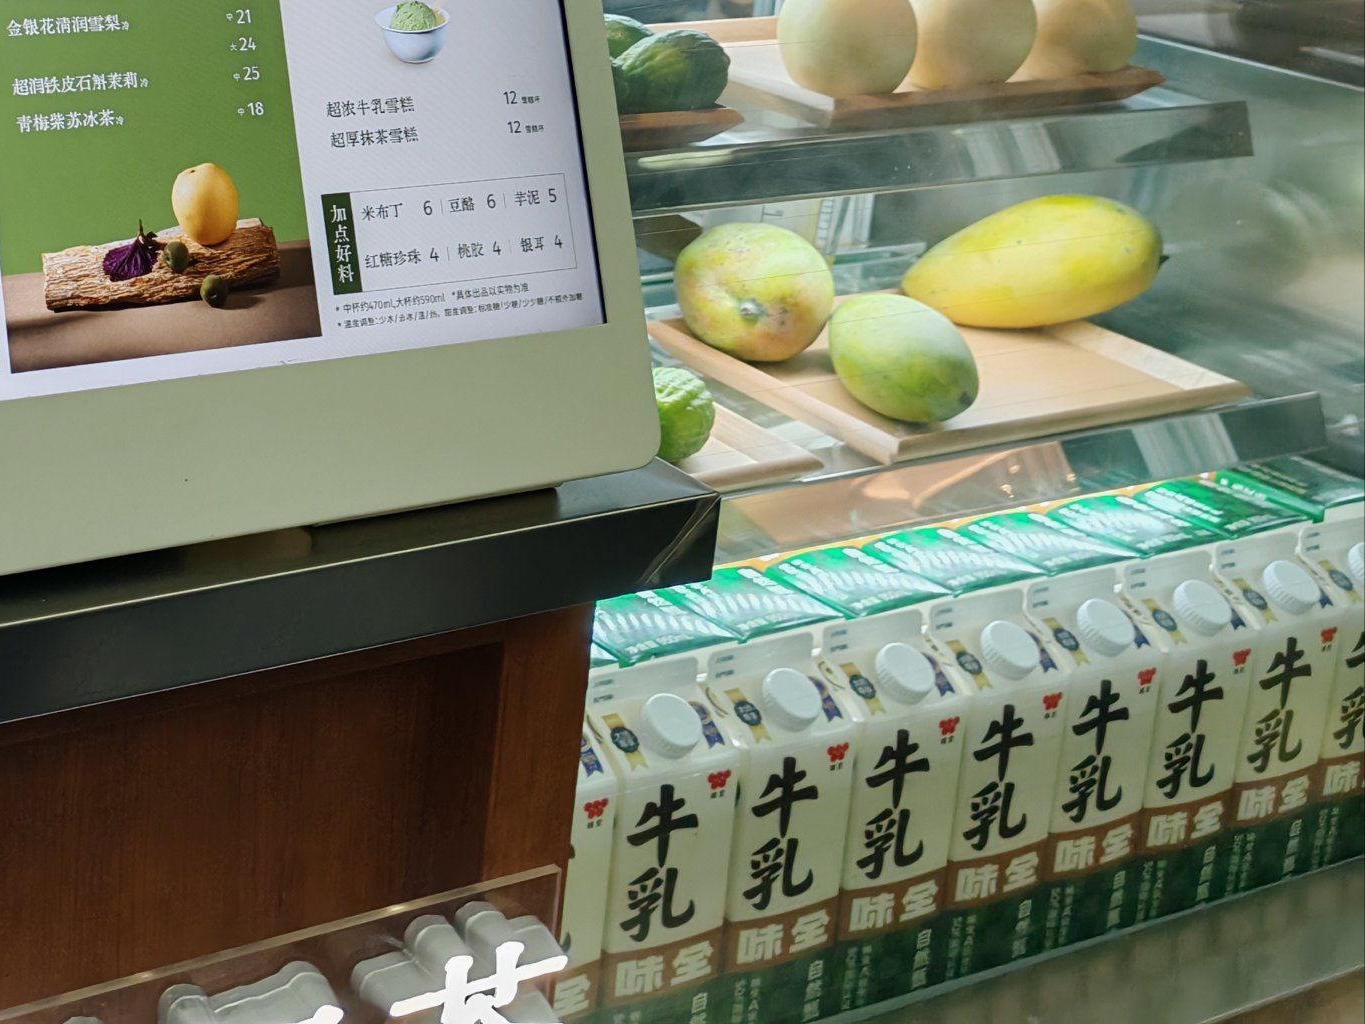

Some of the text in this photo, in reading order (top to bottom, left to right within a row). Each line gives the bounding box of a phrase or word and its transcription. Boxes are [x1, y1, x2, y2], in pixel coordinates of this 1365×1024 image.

[326, 96, 415, 118] 超浓牛乳雪糕
[503, 91, 518, 105] 12
[330, 126, 419, 148] 超厚抹茶雪糕
[507, 121, 522, 134] 12
[361, 202, 403, 221] 米布丁
[423, 200, 433, 216] 6
[486, 194, 497, 209] 6
[514, 189, 541, 207] 芋泥
[548, 188, 557, 203] 5
[330, 205, 355, 283] 加点好料
[364, 235, 563, 269] 红糖珍珠 4 桃胶 4 银耳 4
[1155, 659, 1224, 800] 牛乳
[1247, 636, 1312, 774] 牛乳
[963, 703, 1034, 852] 牛乳
[1061, 678, 1130, 824] 牛乳
[856, 728, 930, 880] 牛乳
[1145, 800, 1224, 848] 味全
[1236, 775, 1310, 822] 味全
[742, 756, 819, 911] 牛乳
[1053, 823, 1134, 874] 味全
[619, 783, 699, 943] 牛乳
[954, 851, 1040, 903] 味全
[848, 878, 939, 933] 味全
[735, 909, 830, 965] 味全
[614, 941, 715, 998] 味全
